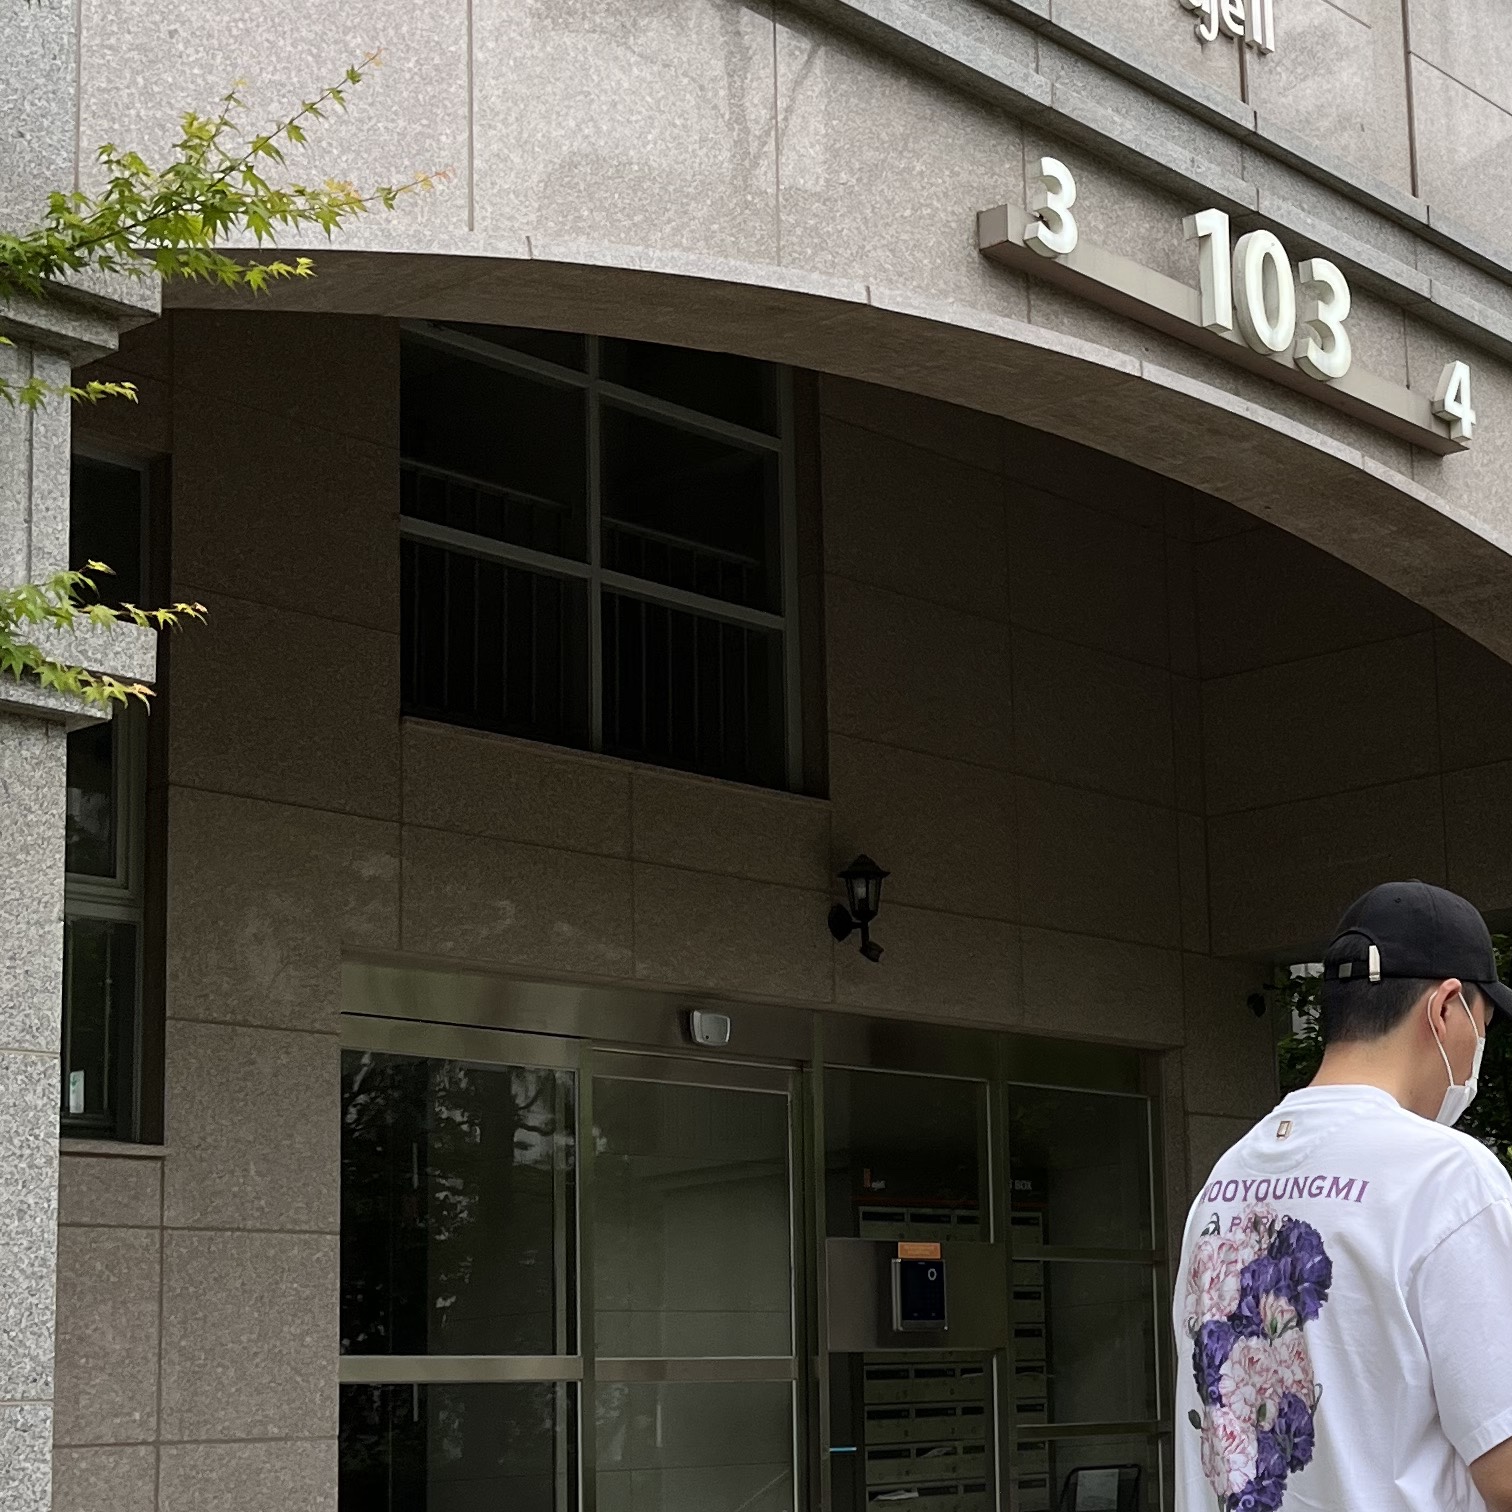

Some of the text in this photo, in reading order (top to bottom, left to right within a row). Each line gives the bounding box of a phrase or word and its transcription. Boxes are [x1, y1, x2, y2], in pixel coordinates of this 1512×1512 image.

[1024, 157, 1476, 443] 3 103 4
